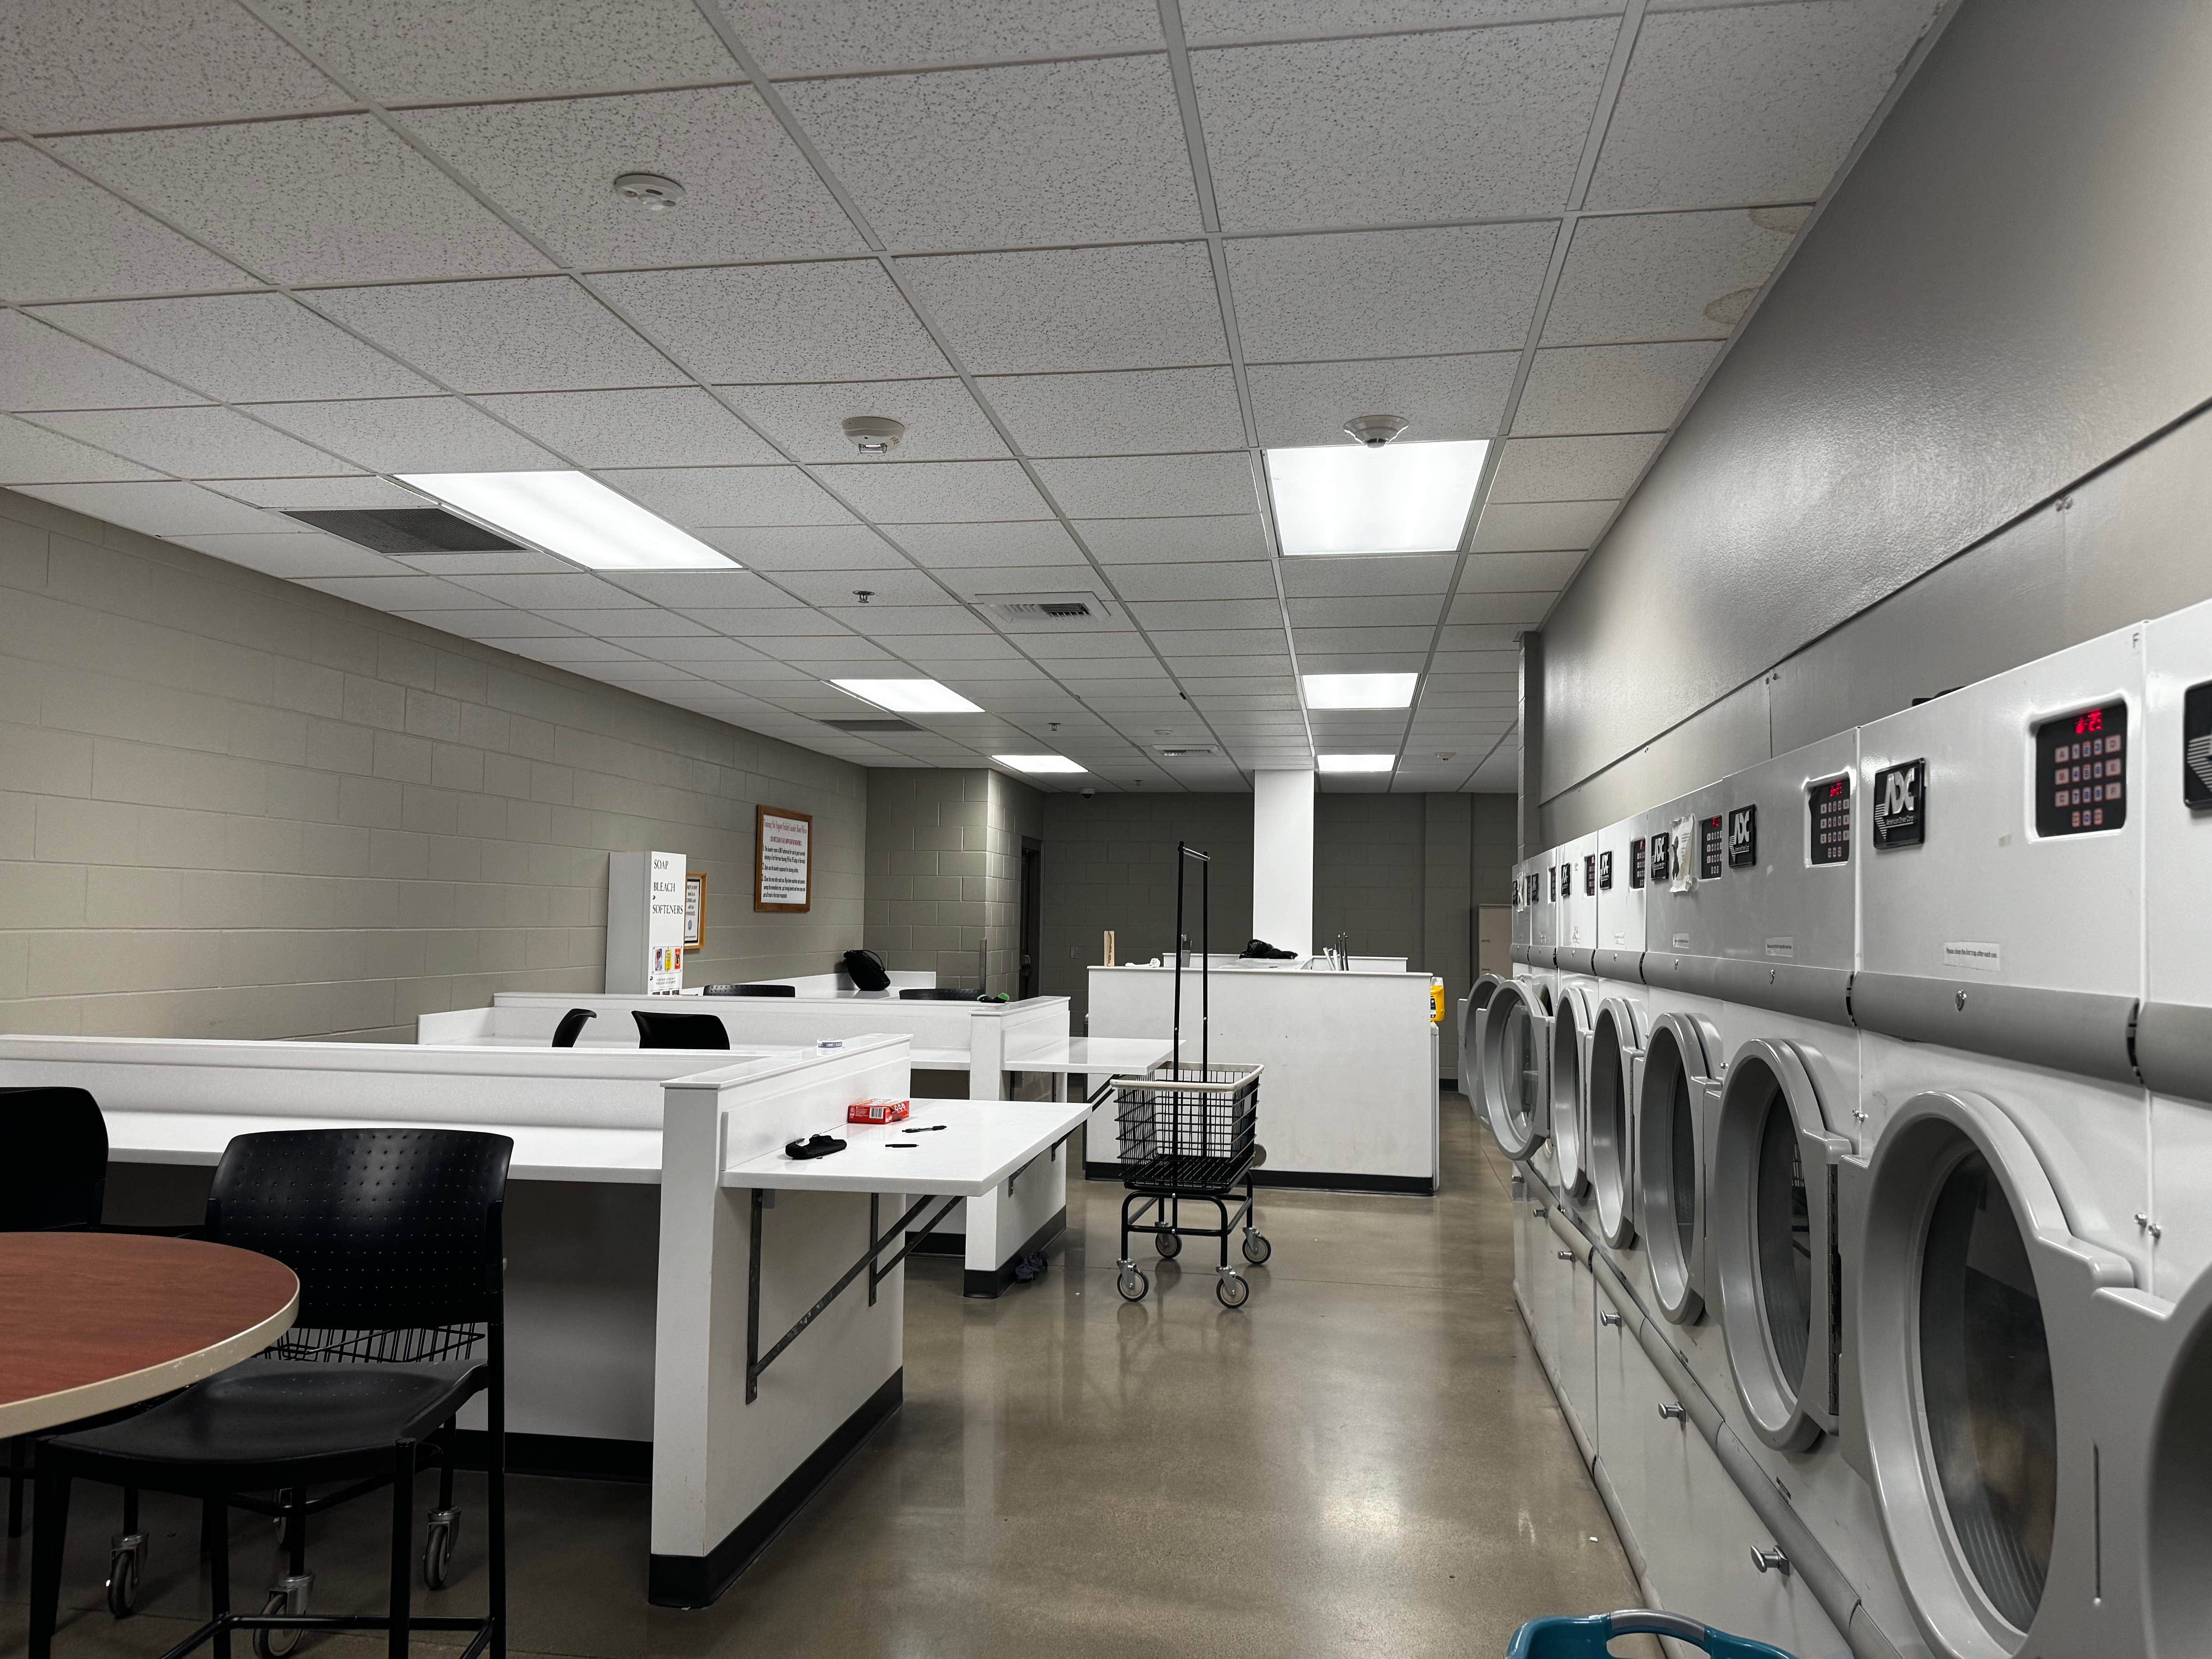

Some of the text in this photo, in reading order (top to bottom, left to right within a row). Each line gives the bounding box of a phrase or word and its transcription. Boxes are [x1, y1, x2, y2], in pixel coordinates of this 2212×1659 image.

[1884, 768, 1915, 815] ADC
[1734, 811, 1750, 845] ADC
[654, 859, 669, 869] SOAP
[653, 882, 675, 892] BLEACH
[652, 904, 684, 914] SOFTENERS
